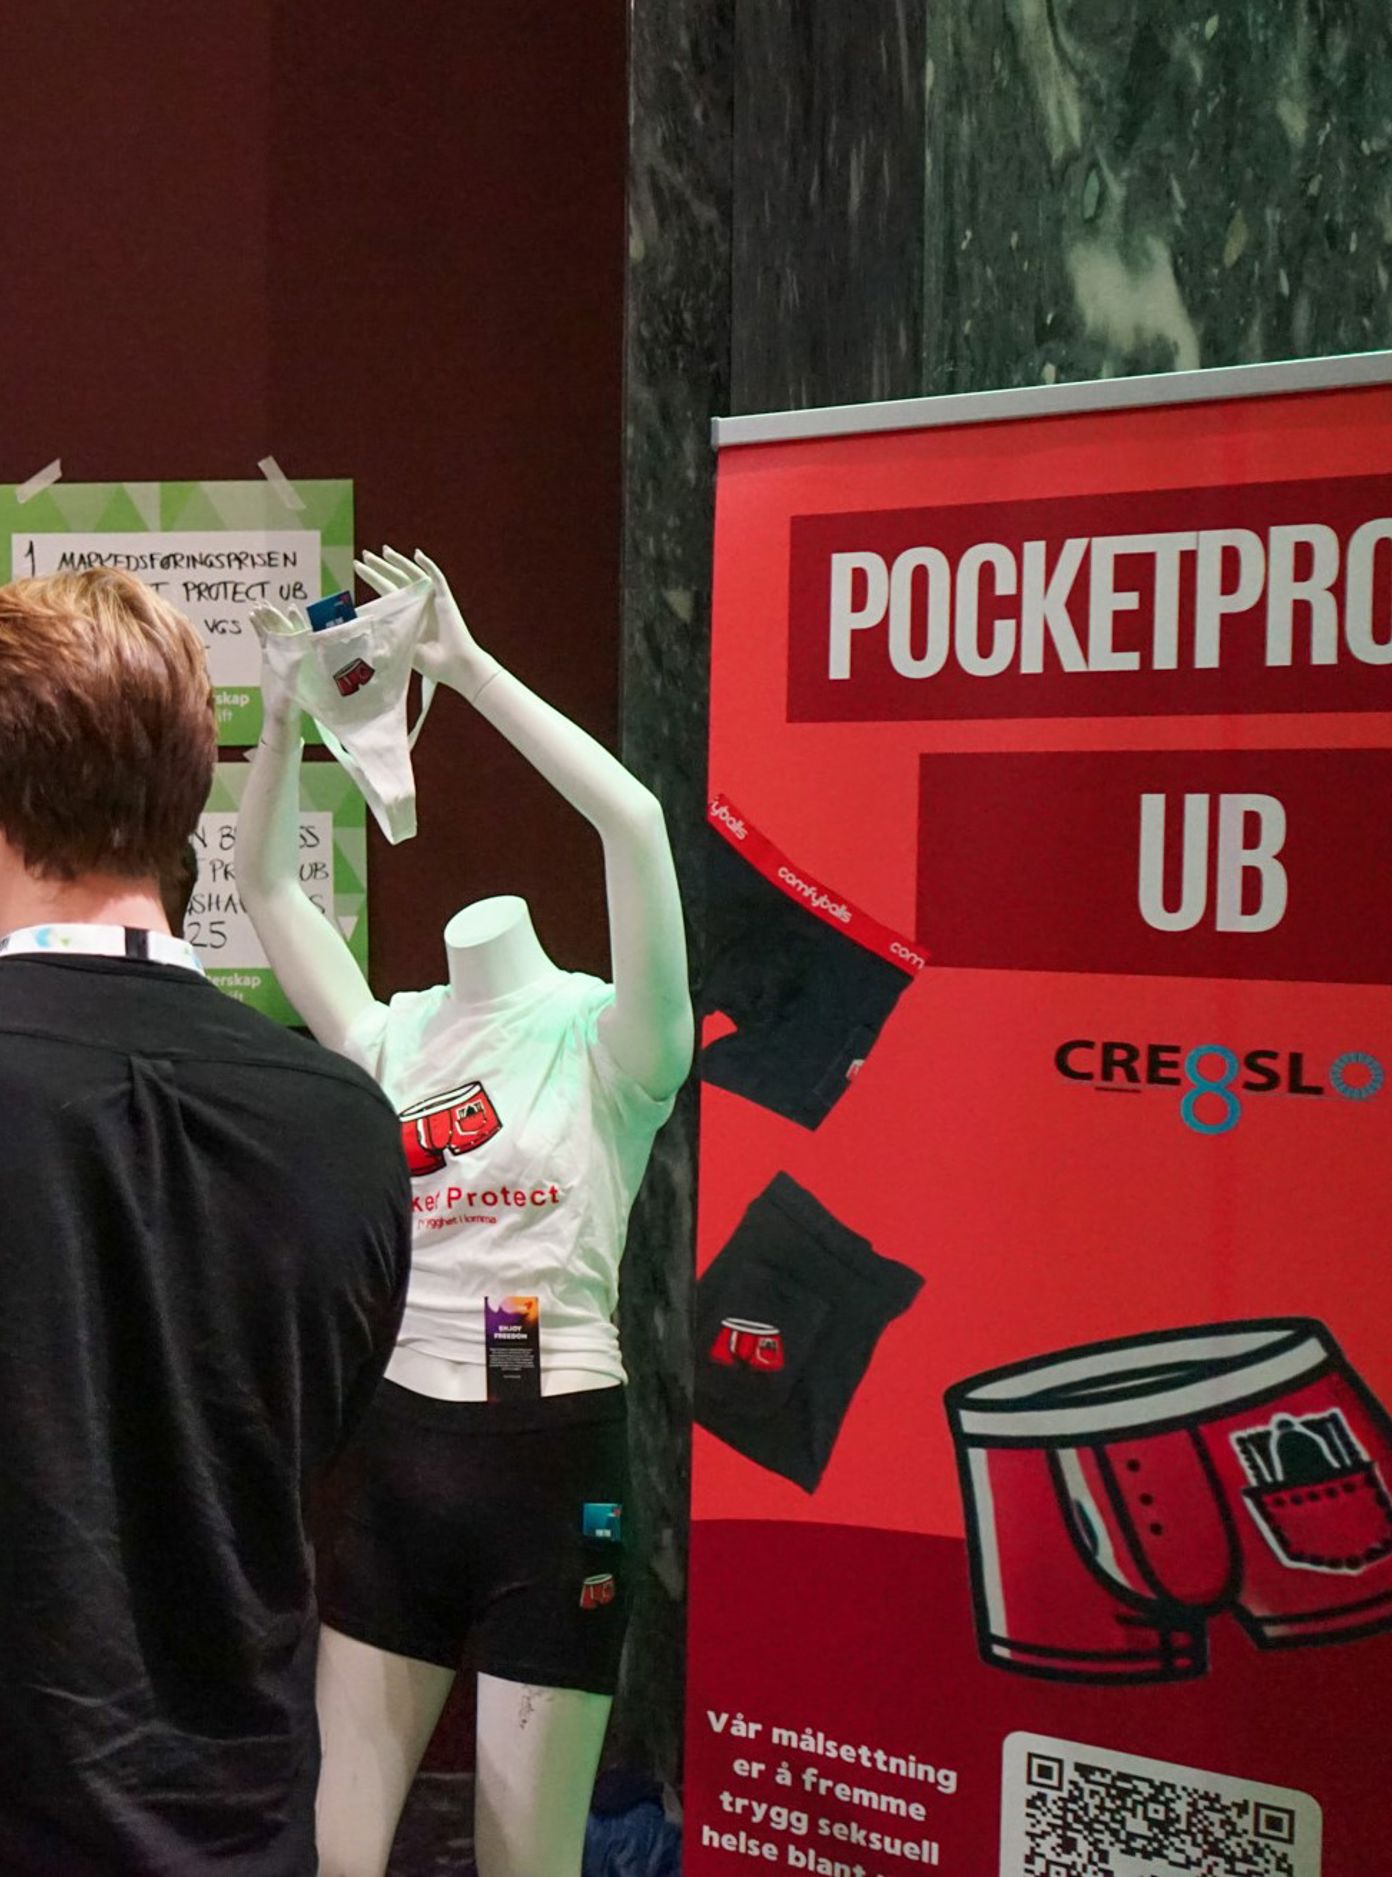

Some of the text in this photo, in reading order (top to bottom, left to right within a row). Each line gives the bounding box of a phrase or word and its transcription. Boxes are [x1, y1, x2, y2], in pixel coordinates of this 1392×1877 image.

[182, 581, 272, 602] PROTECT
[278, 582, 309, 600] UB
[828, 517, 1392, 681] POCKETPRO
[709, 799, 749, 841] yballs
[1137, 793, 1289, 933] UB
[777, 866, 853, 924] comfyballs
[446, 1183, 561, 1210] Protect
[706, 1710, 958, 1794] Vår målsettning
[732, 1758, 927, 1821] er å fremme
[702, 1824, 866, 1877] helse blant
[719, 1790, 940, 1866] trygg seksuell
